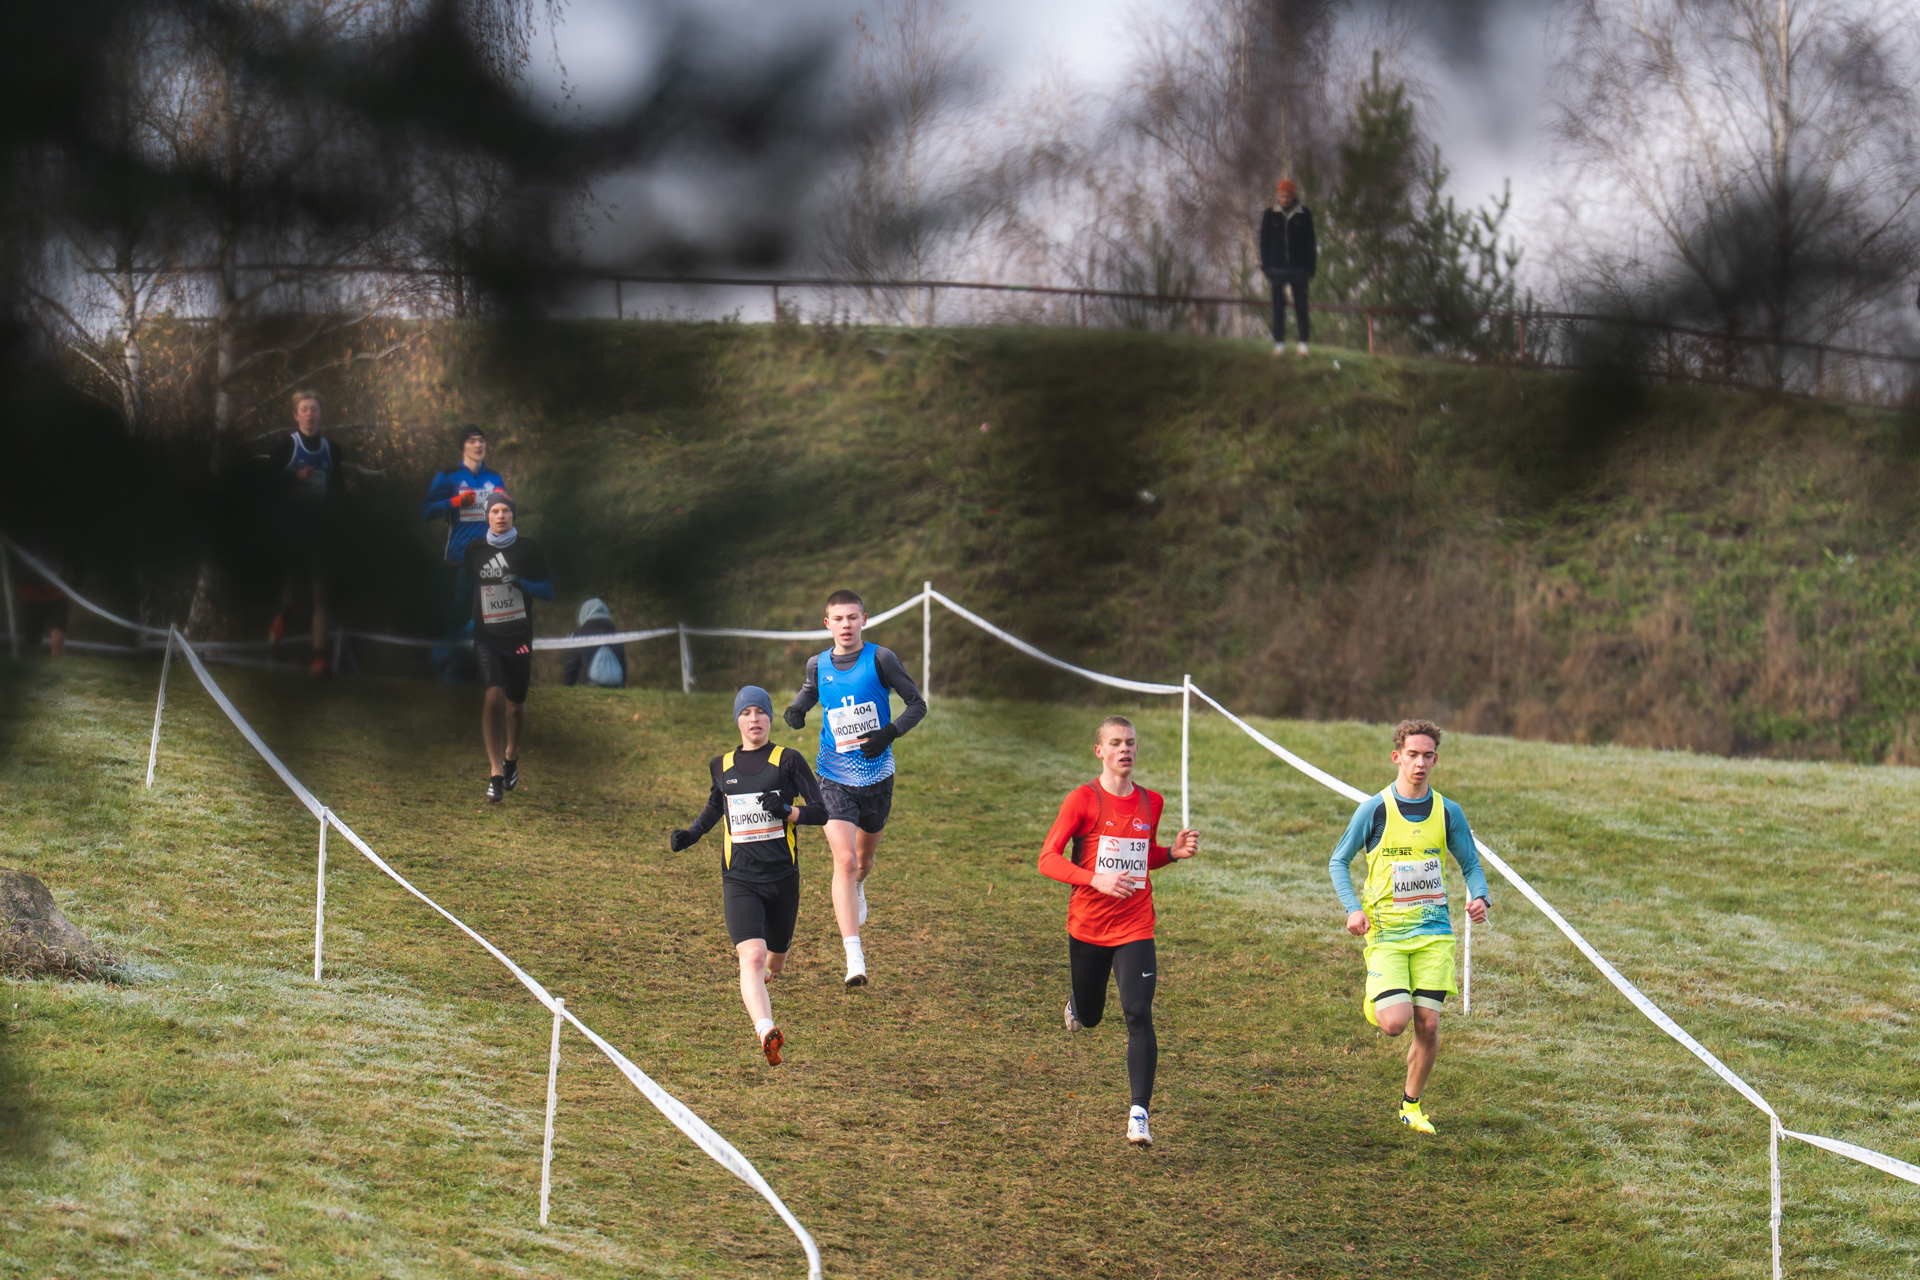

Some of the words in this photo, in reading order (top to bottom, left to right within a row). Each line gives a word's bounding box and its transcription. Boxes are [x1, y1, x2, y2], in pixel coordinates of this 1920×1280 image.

[490, 599, 514, 610] KUSZ
[841, 695, 855, 707] 17
[854, 705, 872, 715] 404
[731, 811, 779, 826] FILIPKOWS
[1130, 841, 1146, 852] 139
[1098, 856, 1147, 871] KOTWICKI
[1424, 860, 1438, 872] 384
